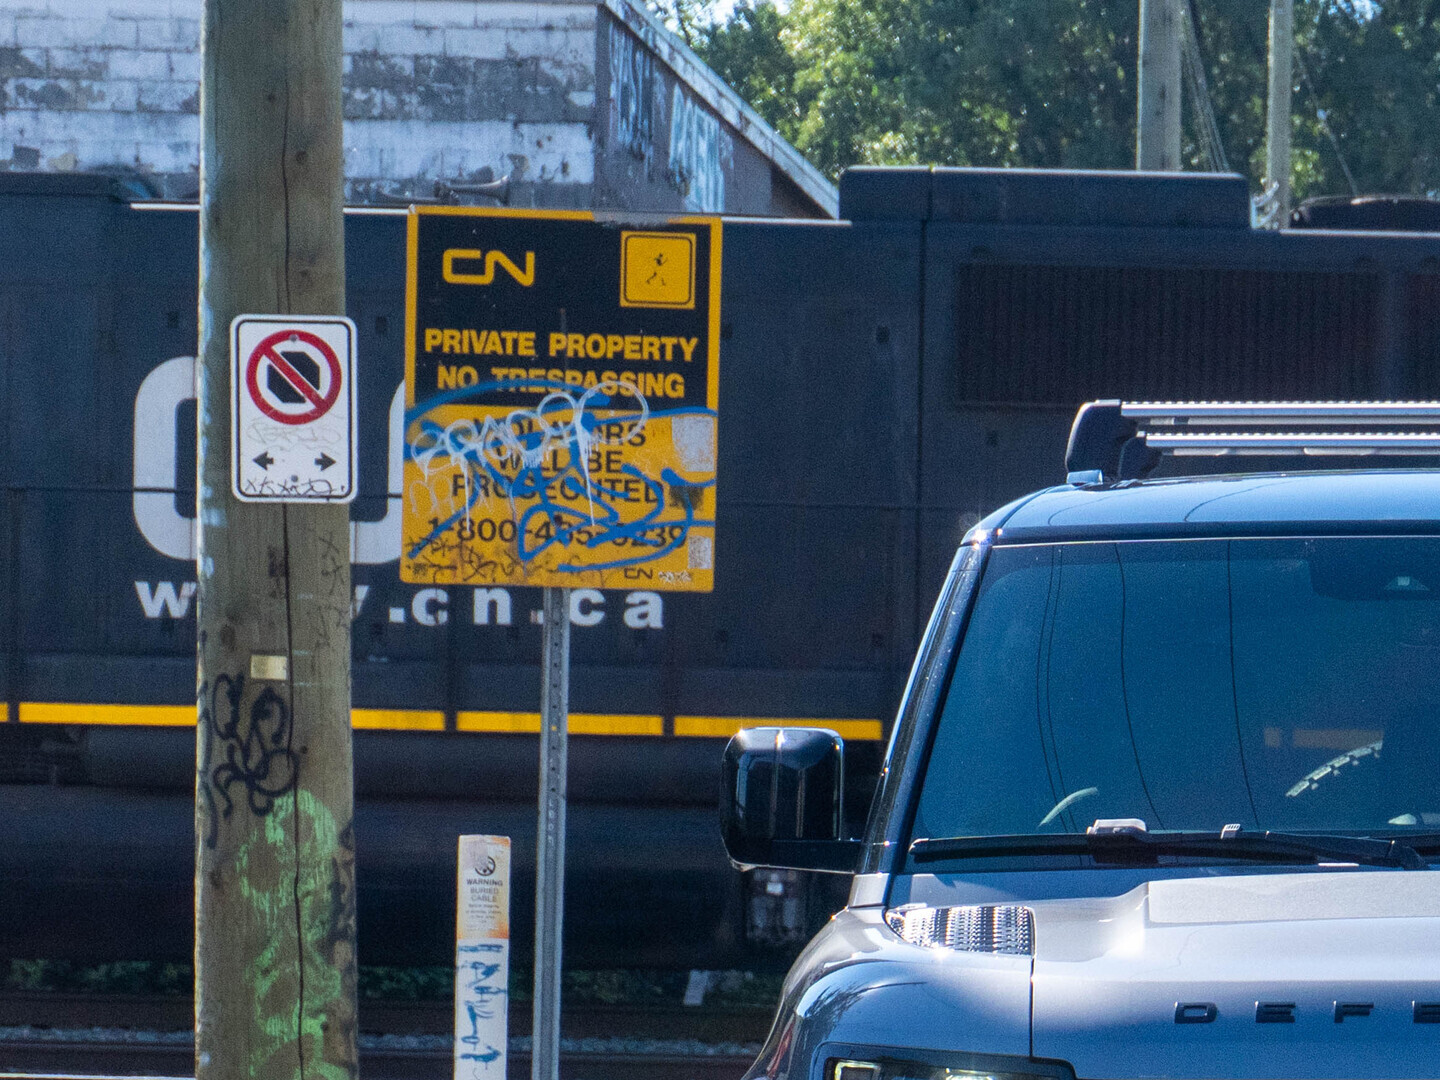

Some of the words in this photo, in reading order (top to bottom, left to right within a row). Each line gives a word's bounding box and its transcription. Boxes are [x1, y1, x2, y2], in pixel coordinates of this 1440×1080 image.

[442, 249, 535, 287] CN
[424, 328, 536, 356] PRIVATE
[549, 333, 699, 362] PROPERTY
[437, 365, 478, 390] NO
[490, 367, 686, 399] TRESPASSING
[587, 450, 623, 474] BE
[466, 878, 504, 887] WARNING
